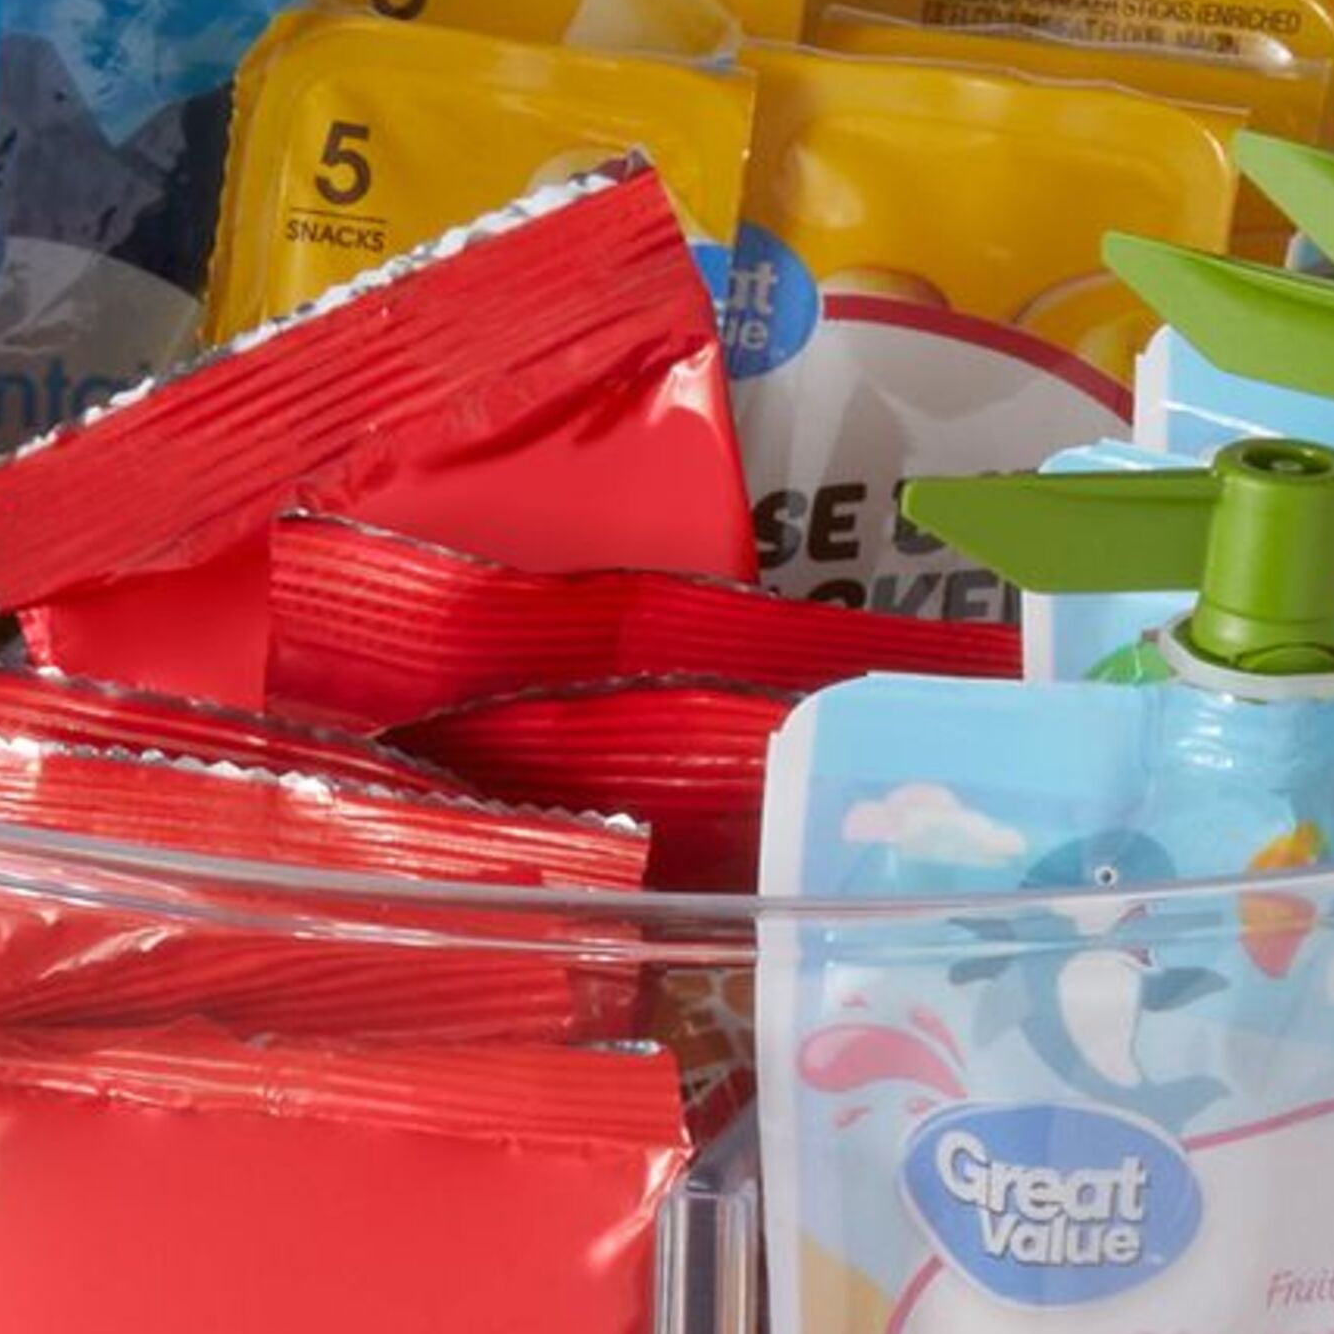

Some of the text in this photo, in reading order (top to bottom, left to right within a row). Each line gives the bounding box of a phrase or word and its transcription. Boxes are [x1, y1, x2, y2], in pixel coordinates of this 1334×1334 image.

[314, 120, 373, 206] 5
[286, 218, 386, 253] SNACKS
[936, 1128, 1149, 1224] Great
[978, 1207, 1143, 1266] Value
